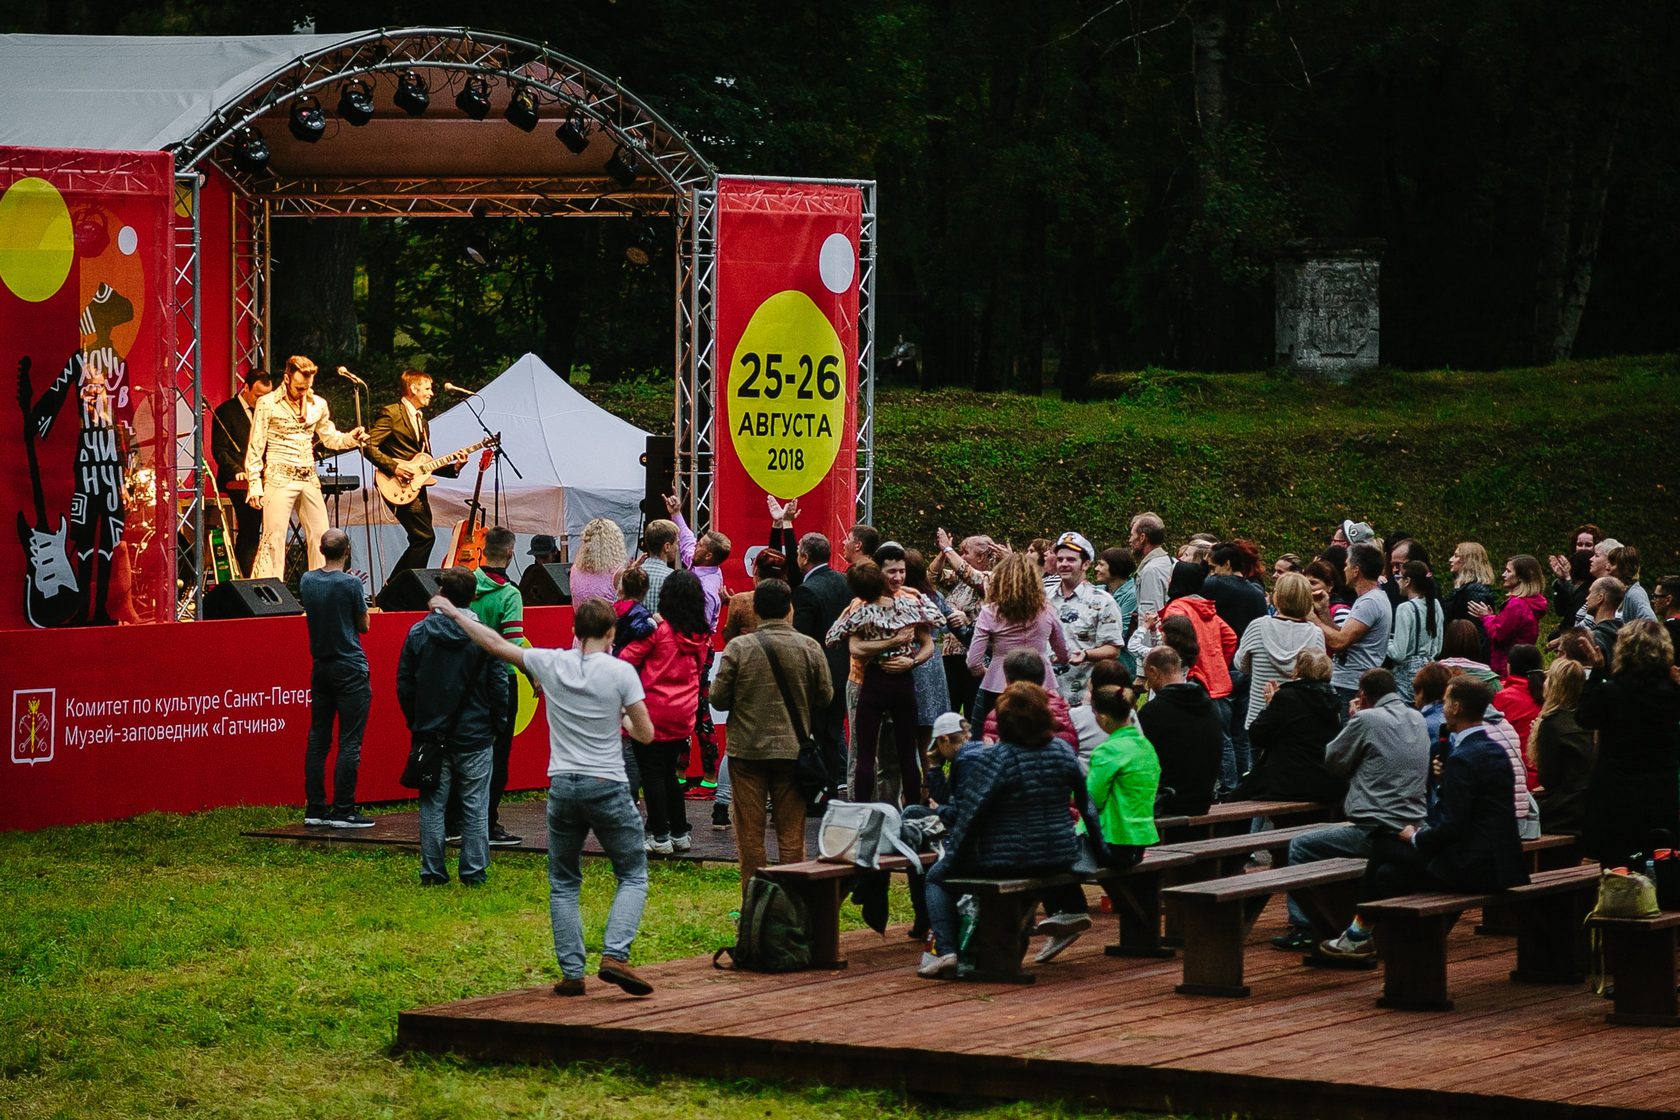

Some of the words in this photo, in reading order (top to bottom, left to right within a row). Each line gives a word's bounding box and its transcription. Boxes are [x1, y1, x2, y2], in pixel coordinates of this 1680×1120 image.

[75, 347, 126, 391] ХОЧУ
[737, 352, 841, 400] 25-26
[737, 412, 832, 438] АВГУСТА
[767, 448, 805, 471] 2018
[65, 698, 129, 718] Комитет
[132, 698, 151, 714] по
[155, 694, 220, 717] культуре
[223, 686, 312, 708] Санкт-Петер
[65, 722, 209, 750] Музей-заповедник
[212, 716, 286, 736] «Гатчина»
